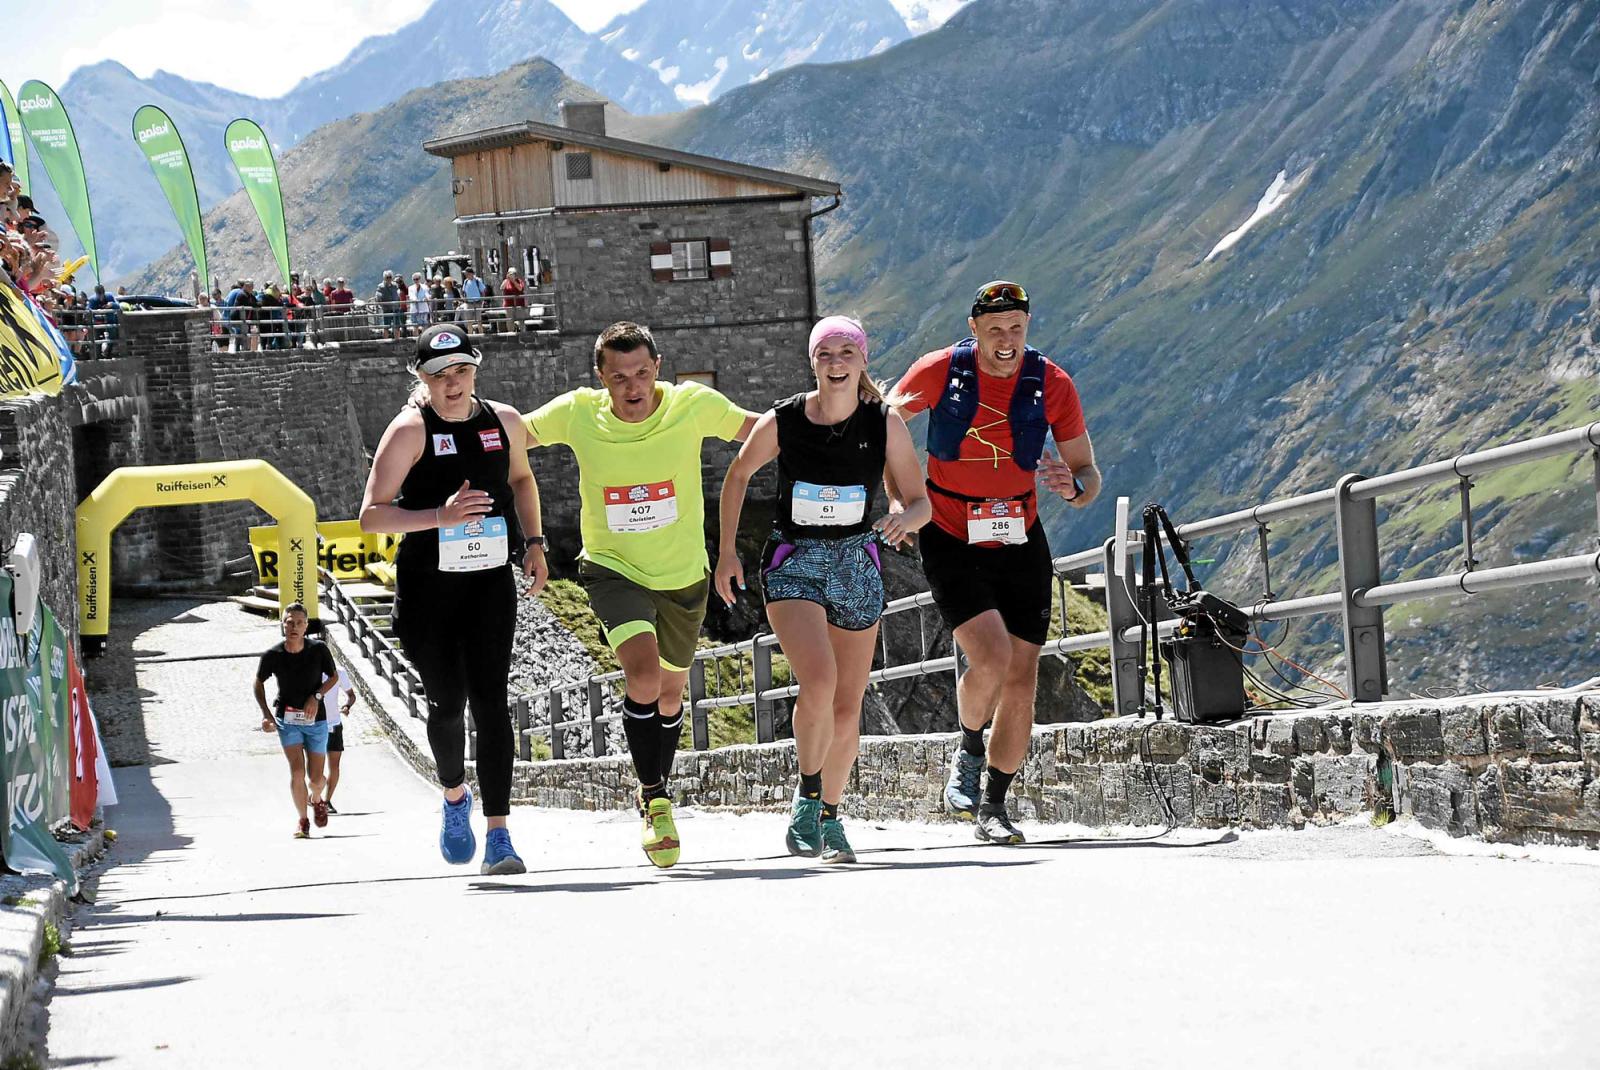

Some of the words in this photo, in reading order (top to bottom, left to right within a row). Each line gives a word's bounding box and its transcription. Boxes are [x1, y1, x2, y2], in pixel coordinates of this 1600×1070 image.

[156, 480, 212, 493] Raiffeisen
[631, 505, 651, 515] 407
[822, 505, 834, 513] 61
[629, 515, 656, 523] Christian
[991, 521, 1010, 530] 286
[467, 542, 481, 551] 60
[293, 554, 303, 605] Raiffeisen
[86, 566, 97, 620] Raiffeisen
